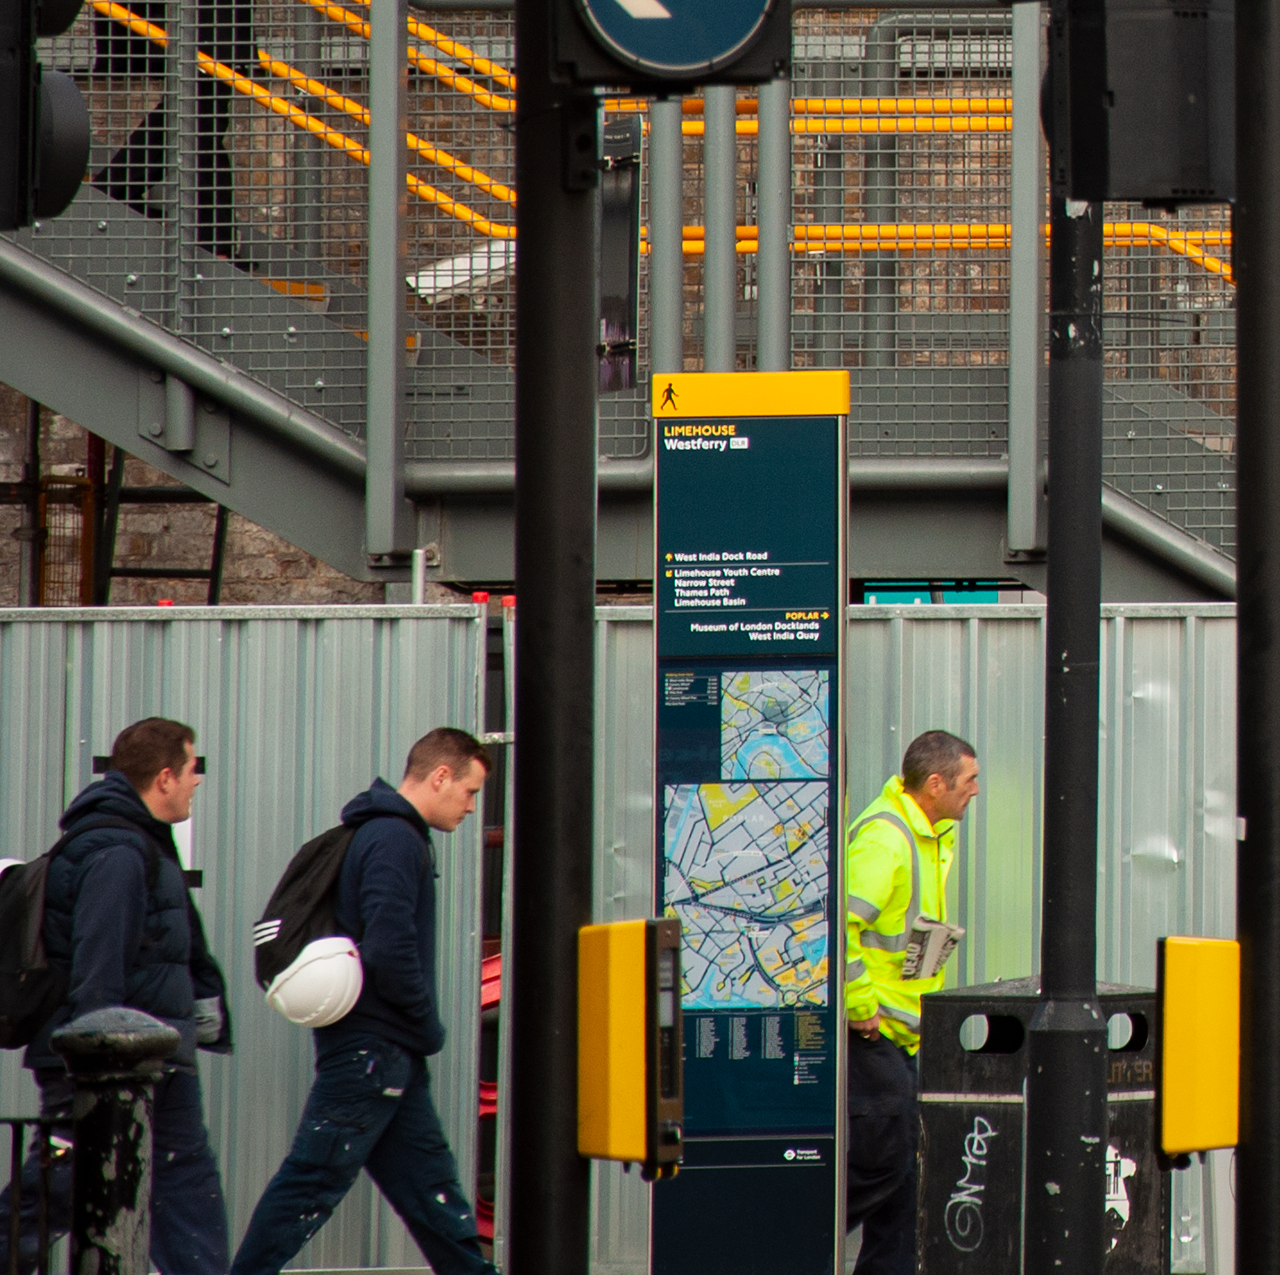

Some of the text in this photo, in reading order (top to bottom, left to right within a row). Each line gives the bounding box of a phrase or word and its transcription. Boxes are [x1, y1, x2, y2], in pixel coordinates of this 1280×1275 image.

[664, 425, 736, 437] LIMEHOUSE
[664, 438, 727, 452] Westferry
[674, 552, 768, 562] West India Dock Road
[674, 568, 780, 578] Limehouse Youth Centre
[674, 578, 735, 587] Narrow Street
[675, 588, 730, 597] Thames Path
[674, 597, 746, 607] Limehouse Basin
[785, 612, 819, 620] POPLAR
[690, 622, 819, 632] Museum of London Docklands
[748, 631, 820, 641] West India Quay
